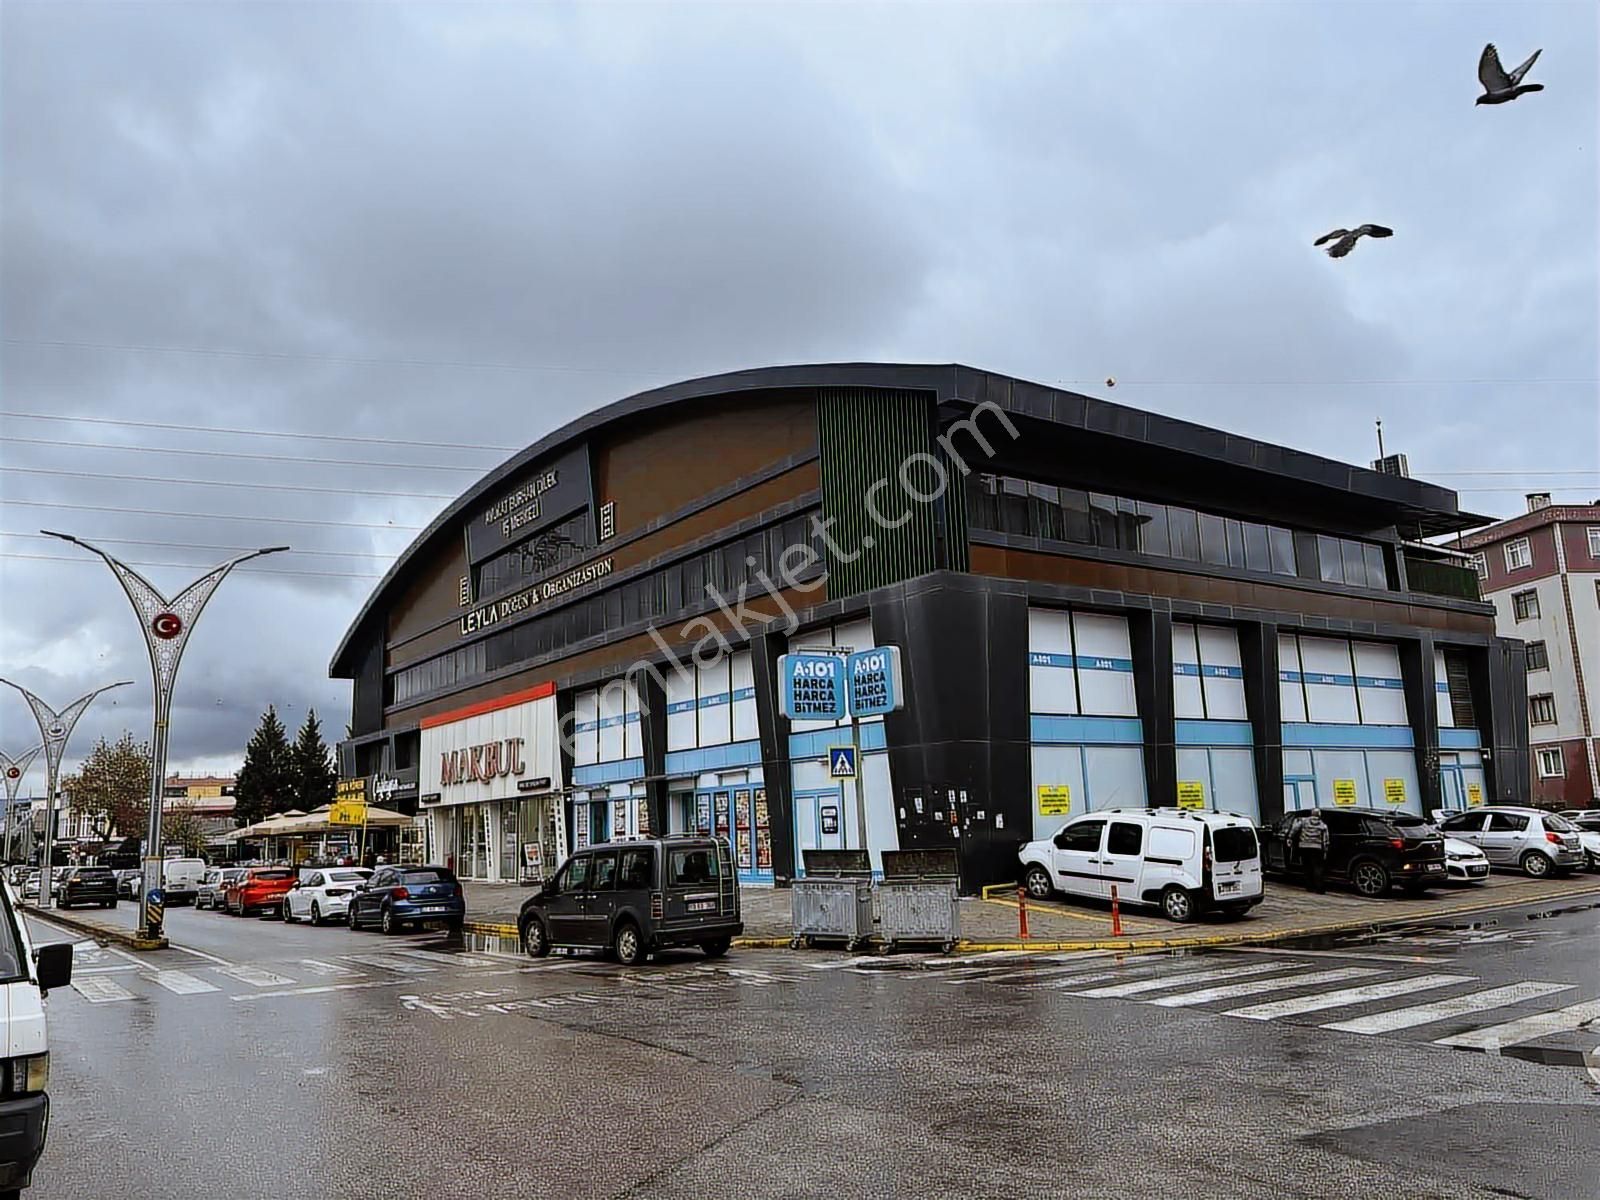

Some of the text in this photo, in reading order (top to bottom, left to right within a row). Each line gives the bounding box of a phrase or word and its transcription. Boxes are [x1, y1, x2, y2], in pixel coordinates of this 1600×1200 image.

[461, 606, 498, 635] LEYLA
[543, 558, 614, 599] ORGANİZASYON
[793, 679, 835, 689] HARCA
[853, 671, 886, 687] HARCA
[793, 690, 836, 702] HARCA
[854, 684, 887, 699] HARCA
[440, 737, 526, 786] MAKBUL
